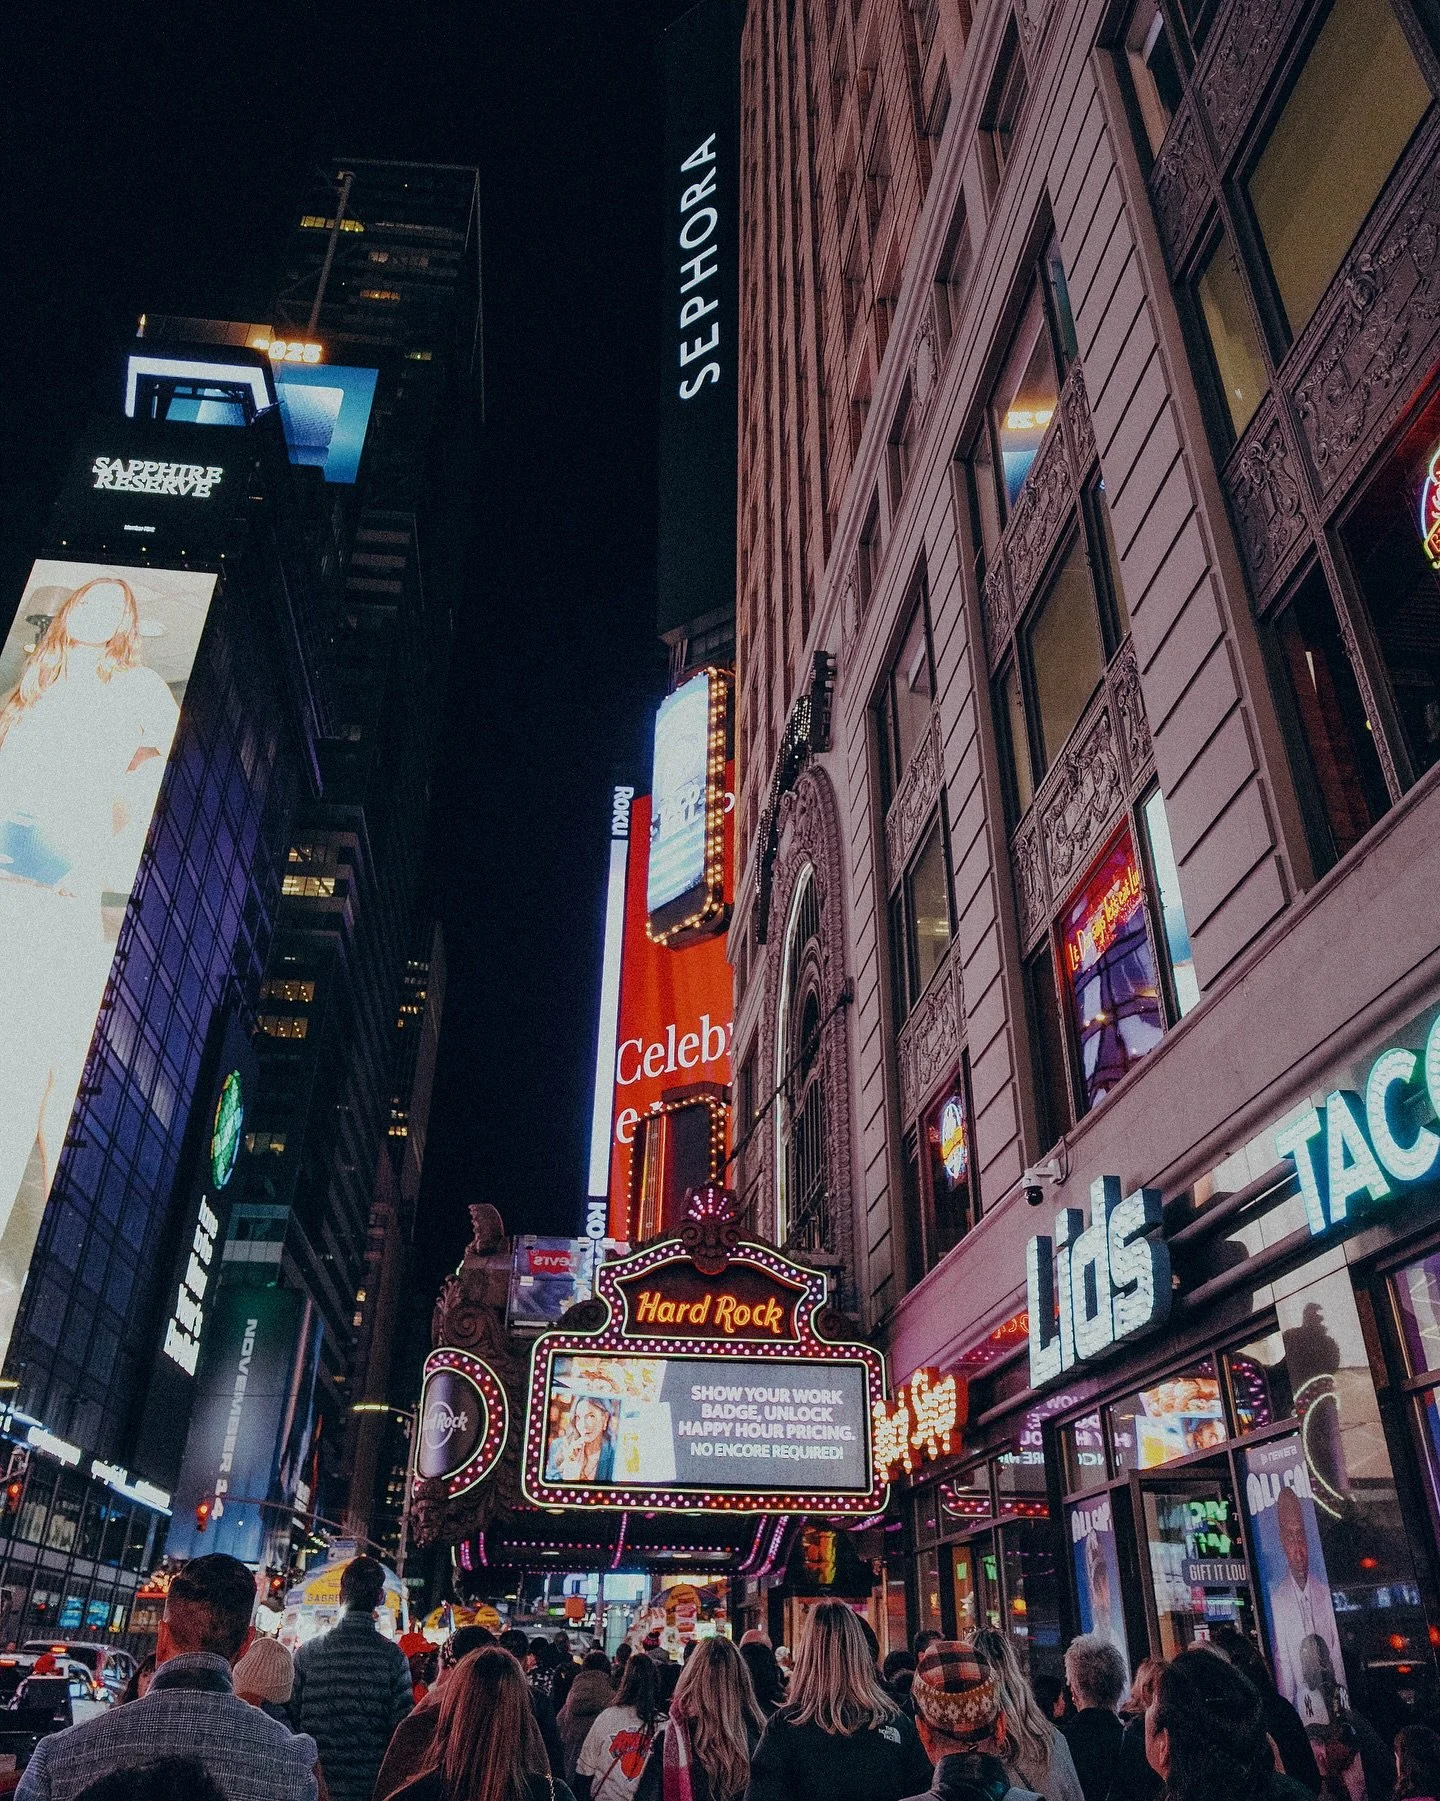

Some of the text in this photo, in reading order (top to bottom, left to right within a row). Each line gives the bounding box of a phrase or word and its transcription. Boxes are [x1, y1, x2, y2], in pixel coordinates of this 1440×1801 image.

[679, 132, 721, 400] SEPHORA
[92, 456, 223, 484] SAPPHIRE
[93, 470, 213, 498] RESERVE
[1275, 1012, 1440, 1236] TAC
[1026, 1175, 1156, 1390] Lids
[635, 1292, 785, 1334] Hard Rock
[218, 1319, 258, 1473] NOVEMBER
[691, 1385, 844, 1405] SHOW YOUR WORK
[437, 1411, 469, 1433] Rock
[701, 1403, 834, 1422] BADGE, UNLOCK
[678, 1421, 857, 1441] HAPPY HOUR PRICING.
[690, 1442, 844, 1462] NO ENCORE REQUIRED!
[1189, 1564, 1247, 1581] GIFT IT LOU
